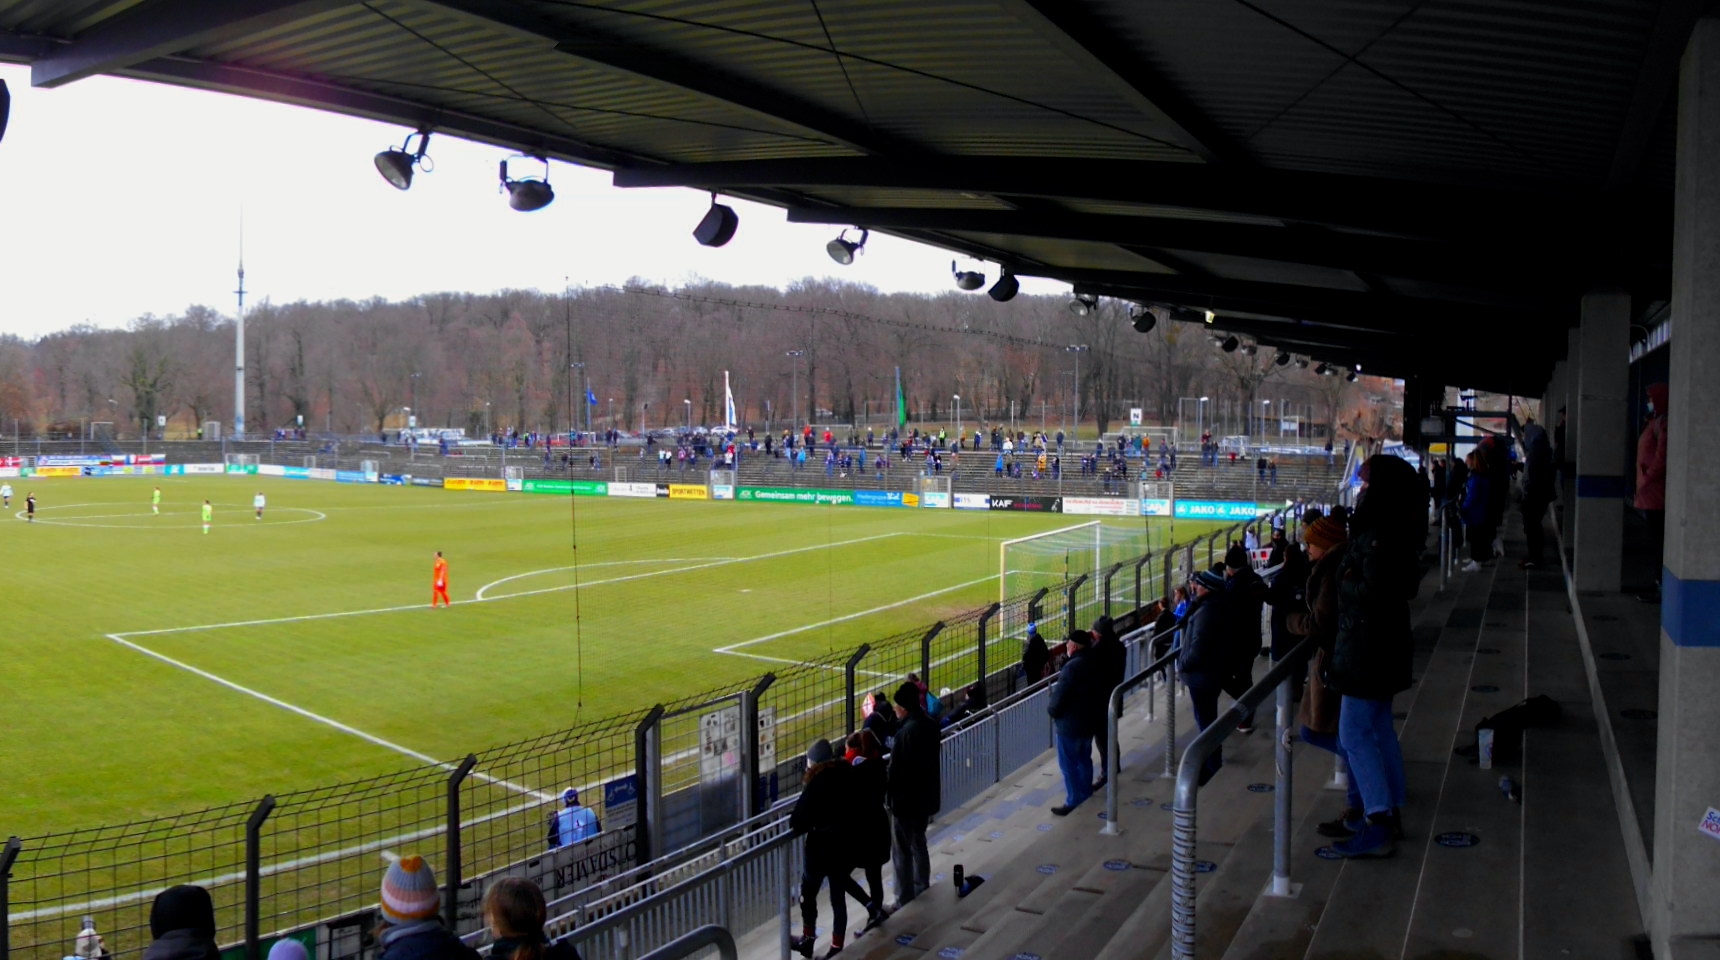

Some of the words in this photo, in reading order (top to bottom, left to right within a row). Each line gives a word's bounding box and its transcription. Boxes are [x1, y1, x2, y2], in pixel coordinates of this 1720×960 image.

[754, 491, 795, 500] Gemeinsam
[797, 491, 815, 501] mehr
[1190, 504, 1215, 515] JAKO
[1229, 505, 1256, 516] JAKO
